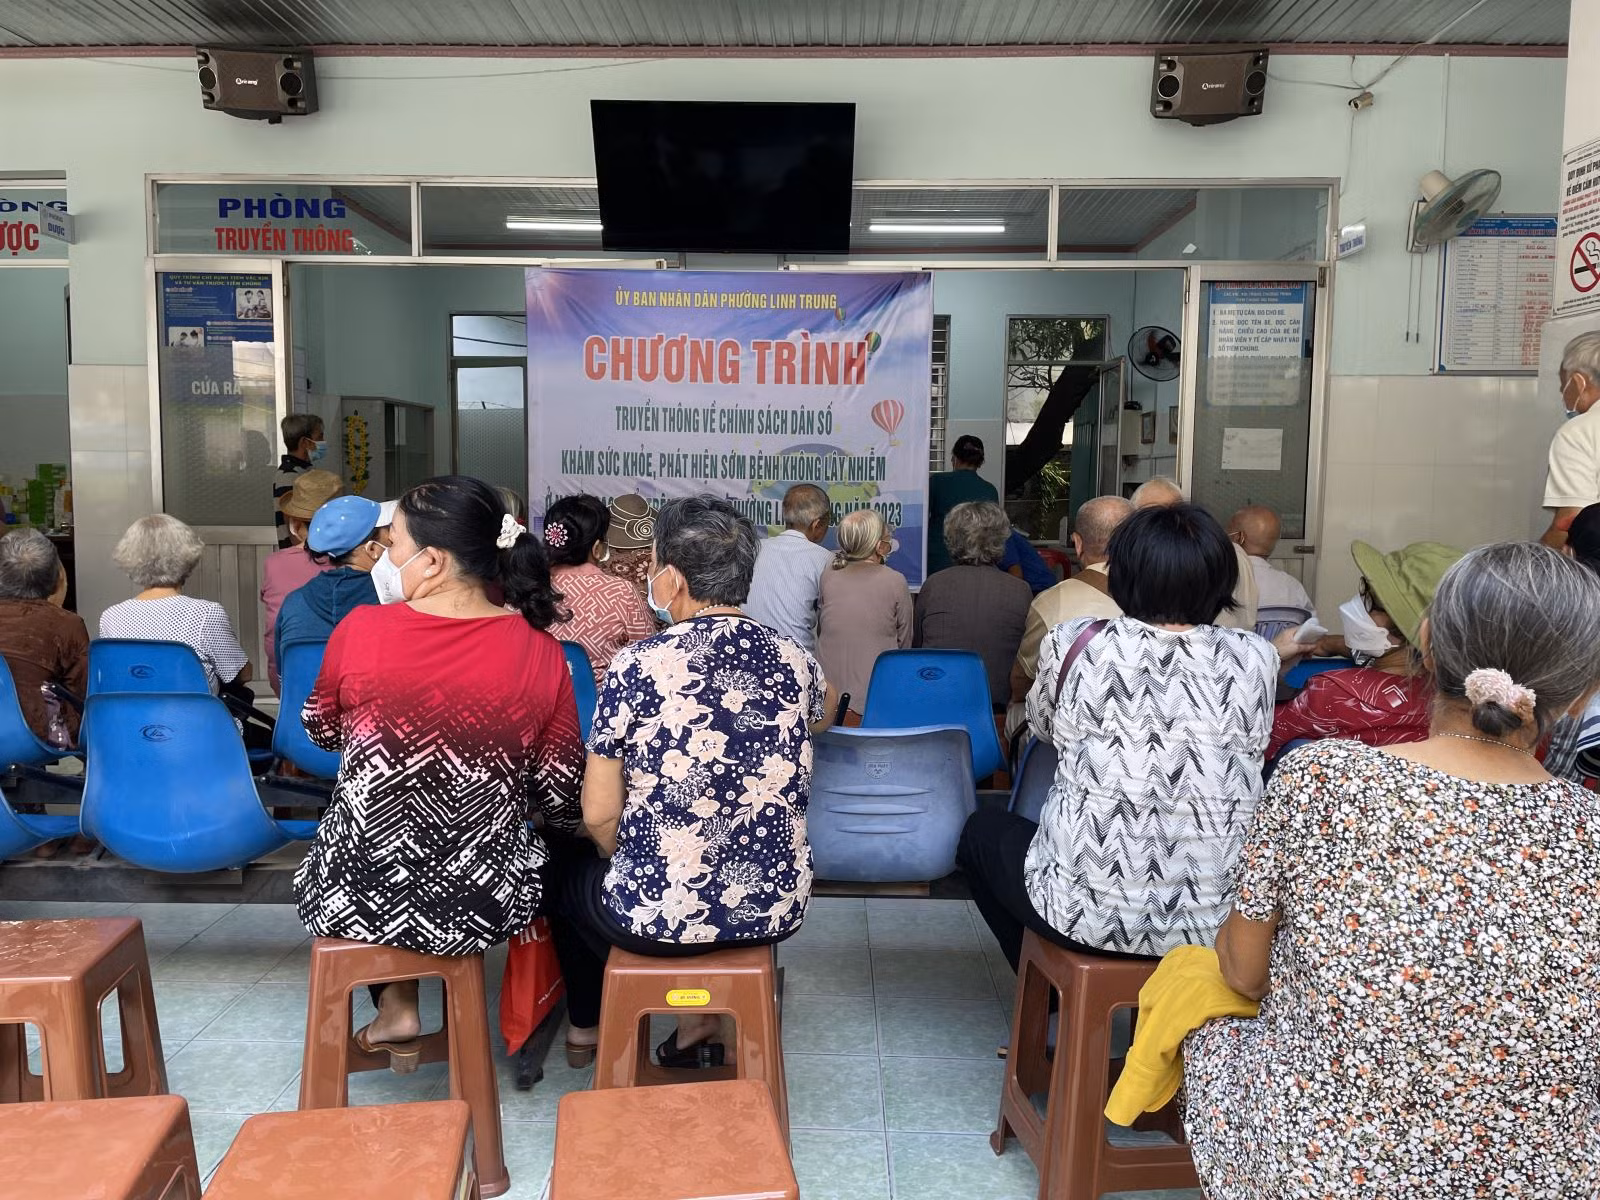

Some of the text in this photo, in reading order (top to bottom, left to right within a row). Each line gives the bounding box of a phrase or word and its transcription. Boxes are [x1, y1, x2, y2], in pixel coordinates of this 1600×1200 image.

[0, 198, 67, 212] ÒNG
[219, 193, 346, 218] PHÒNG
[292, 224, 353, 252] THÔNG
[616, 286, 837, 309] ỦY BAN NHÂN DÂN PHƯỜNG LINH TRUNG
[584, 330, 867, 385] CHƯƠNG TRÌNH
[223, 381, 241, 395] RA
[662, 402, 700, 432] THÔNG
[703, 400, 716, 433] VỀ
[719, 403, 754, 434] CHÍNH
[757, 404, 788, 434] SÁCH
[791, 404, 814, 435] DÂN
[817, 401, 833, 435] SỐ
[562, 444, 594, 475] KHÁM
[597, 446, 620, 476] SỨC
[660, 448, 688, 478] PHÁT
[691, 449, 718, 484] HIỆN
[721, 450, 746, 479] SỚM
[749, 452, 780, 485] BỆNH
[783, 451, 821, 481] KHÔNG
[825, 451, 845, 481] LÂY
[849, 448, 886, 481] NHIỄM
